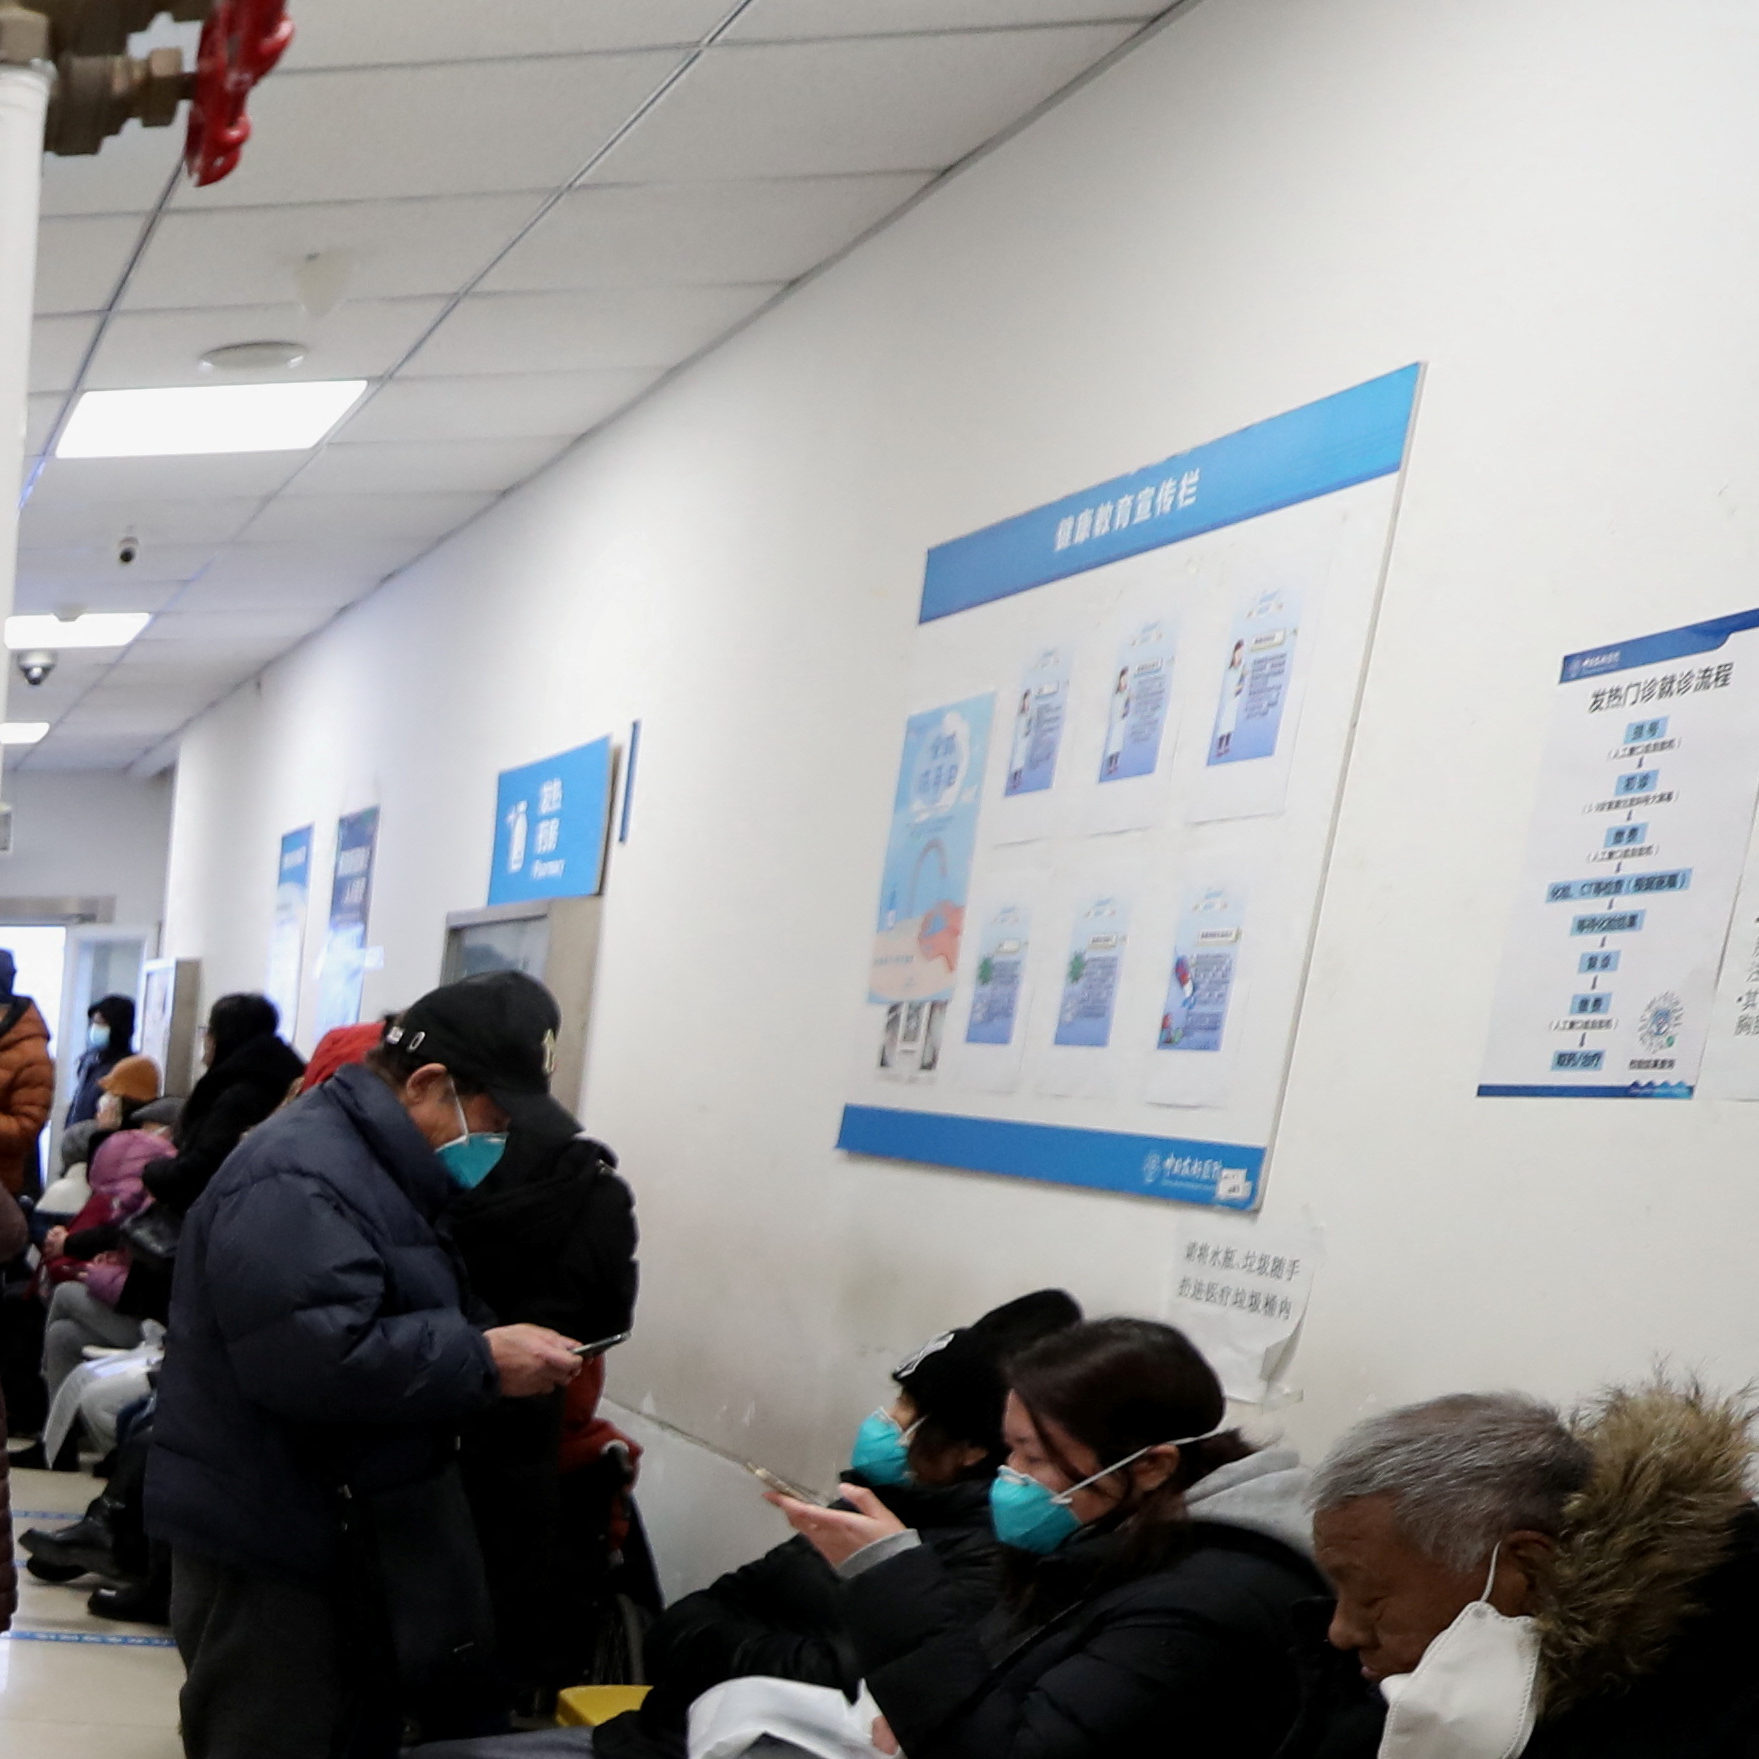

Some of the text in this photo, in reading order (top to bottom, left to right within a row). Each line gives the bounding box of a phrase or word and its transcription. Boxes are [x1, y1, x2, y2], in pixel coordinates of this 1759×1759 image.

[1054, 467, 1201, 552] 健康教育宣传栏
[1588, 661, 1734, 714] 发热门诊就诊流程
[1178, 1274, 1293, 1321] 扔进医疗垃圾桶内
